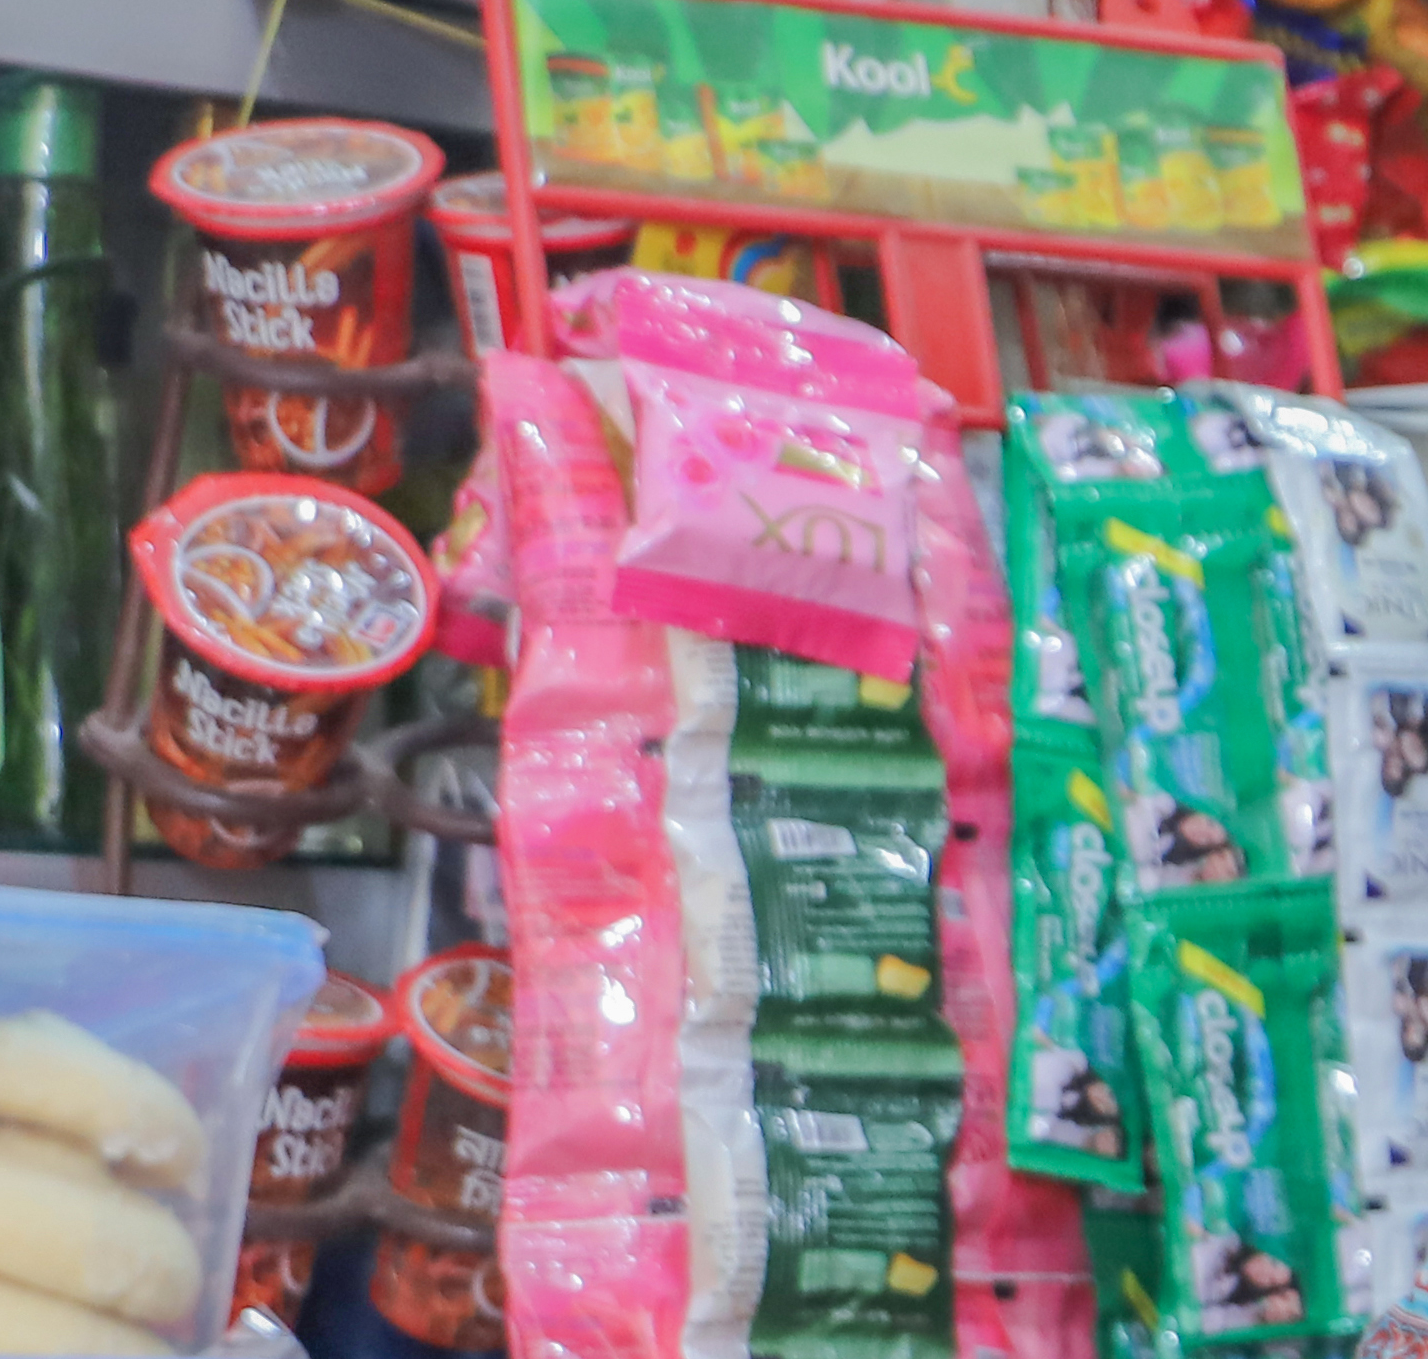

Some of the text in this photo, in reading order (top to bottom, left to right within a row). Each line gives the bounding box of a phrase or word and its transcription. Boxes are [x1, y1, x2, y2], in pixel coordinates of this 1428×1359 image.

[823, 42, 933, 98] Kool
[223, 297, 315, 353] Stick
[738, 490, 886, 574] LUX
[1122, 552, 1180, 731] closeup
[1193, 990, 1253, 1168] closeup
